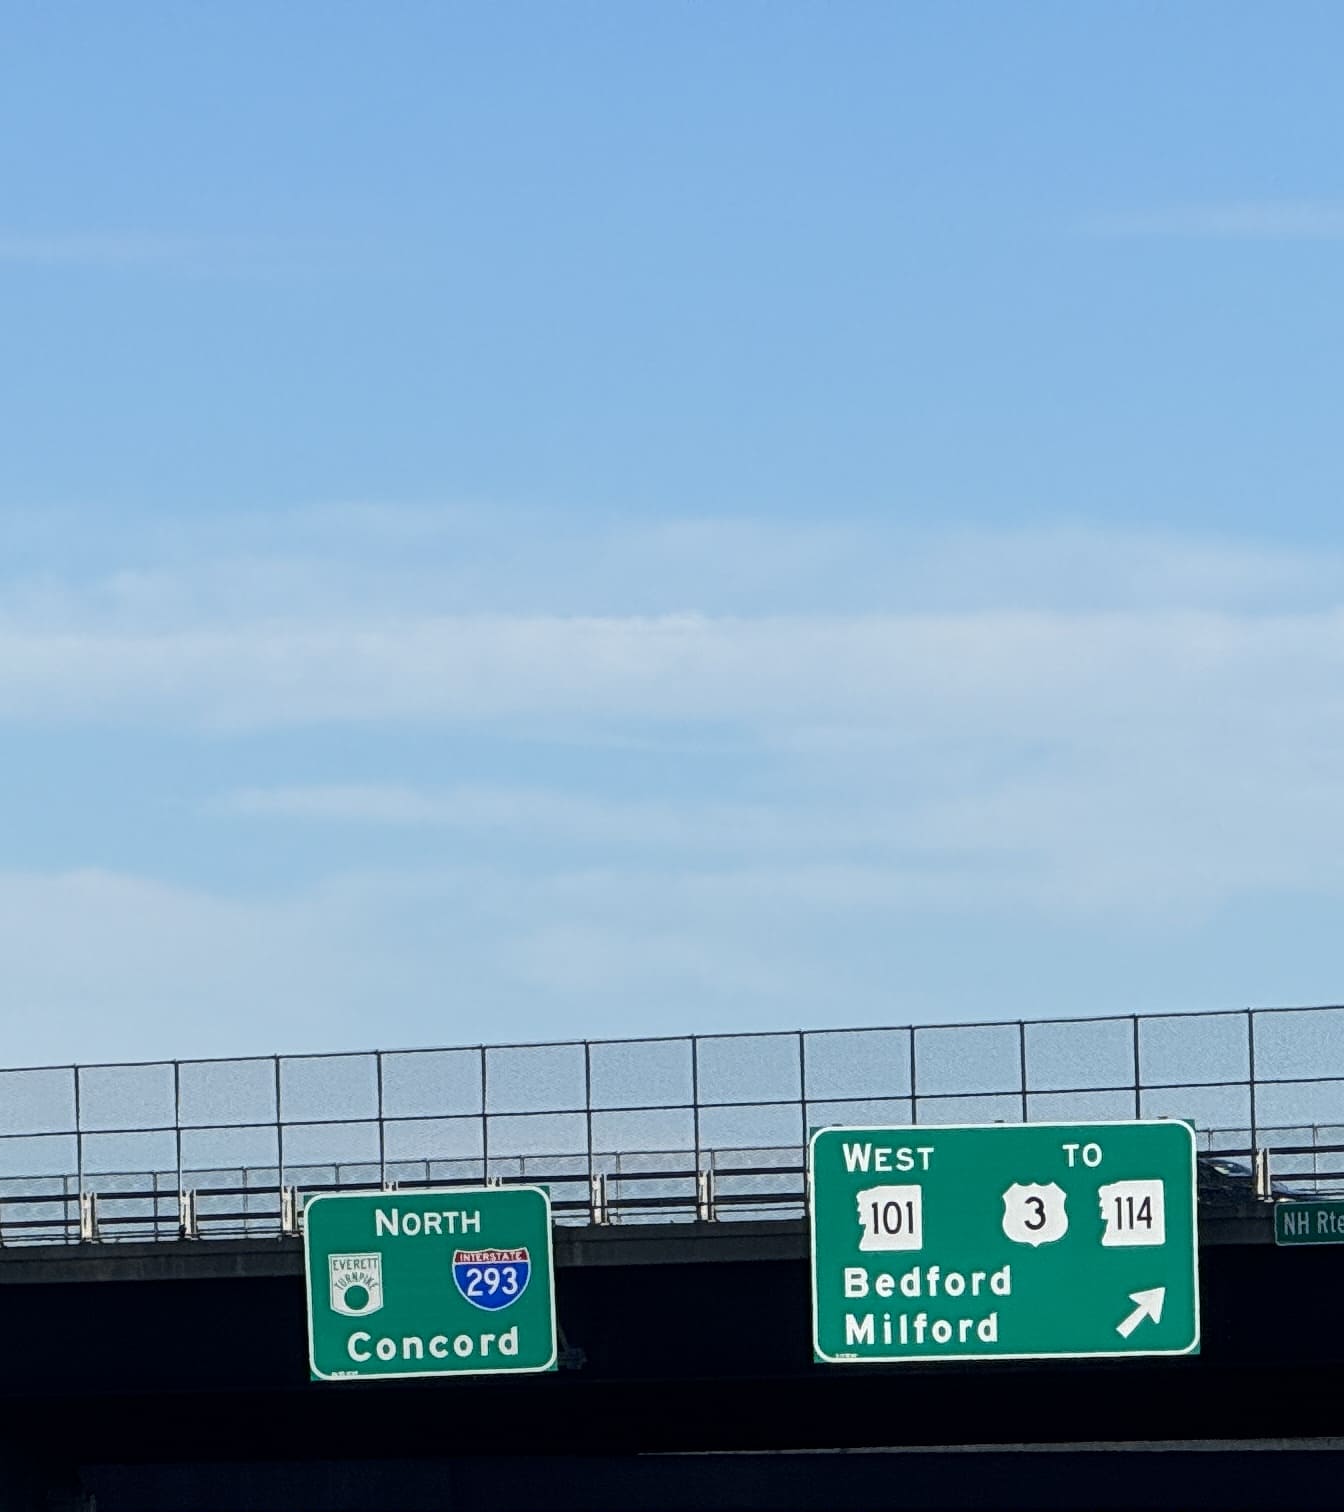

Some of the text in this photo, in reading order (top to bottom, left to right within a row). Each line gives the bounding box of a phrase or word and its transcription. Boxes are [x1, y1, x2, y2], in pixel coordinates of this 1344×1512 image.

[842, 1143, 1103, 1172] WEST TO
[375, 1208, 481, 1237] NORTH
[871, 1195, 1153, 1235] 101 3 114
[1283, 1210, 1310, 1236] NH
[332, 1257, 378, 1271] EVERETT
[460, 1251, 523, 1262] INTERSTATE
[466, 1267, 519, 1297] 293
[844, 1265, 1011, 1298] Bedford
[845, 1311, 999, 1346] Milford
[347, 1325, 519, 1362] Concord
